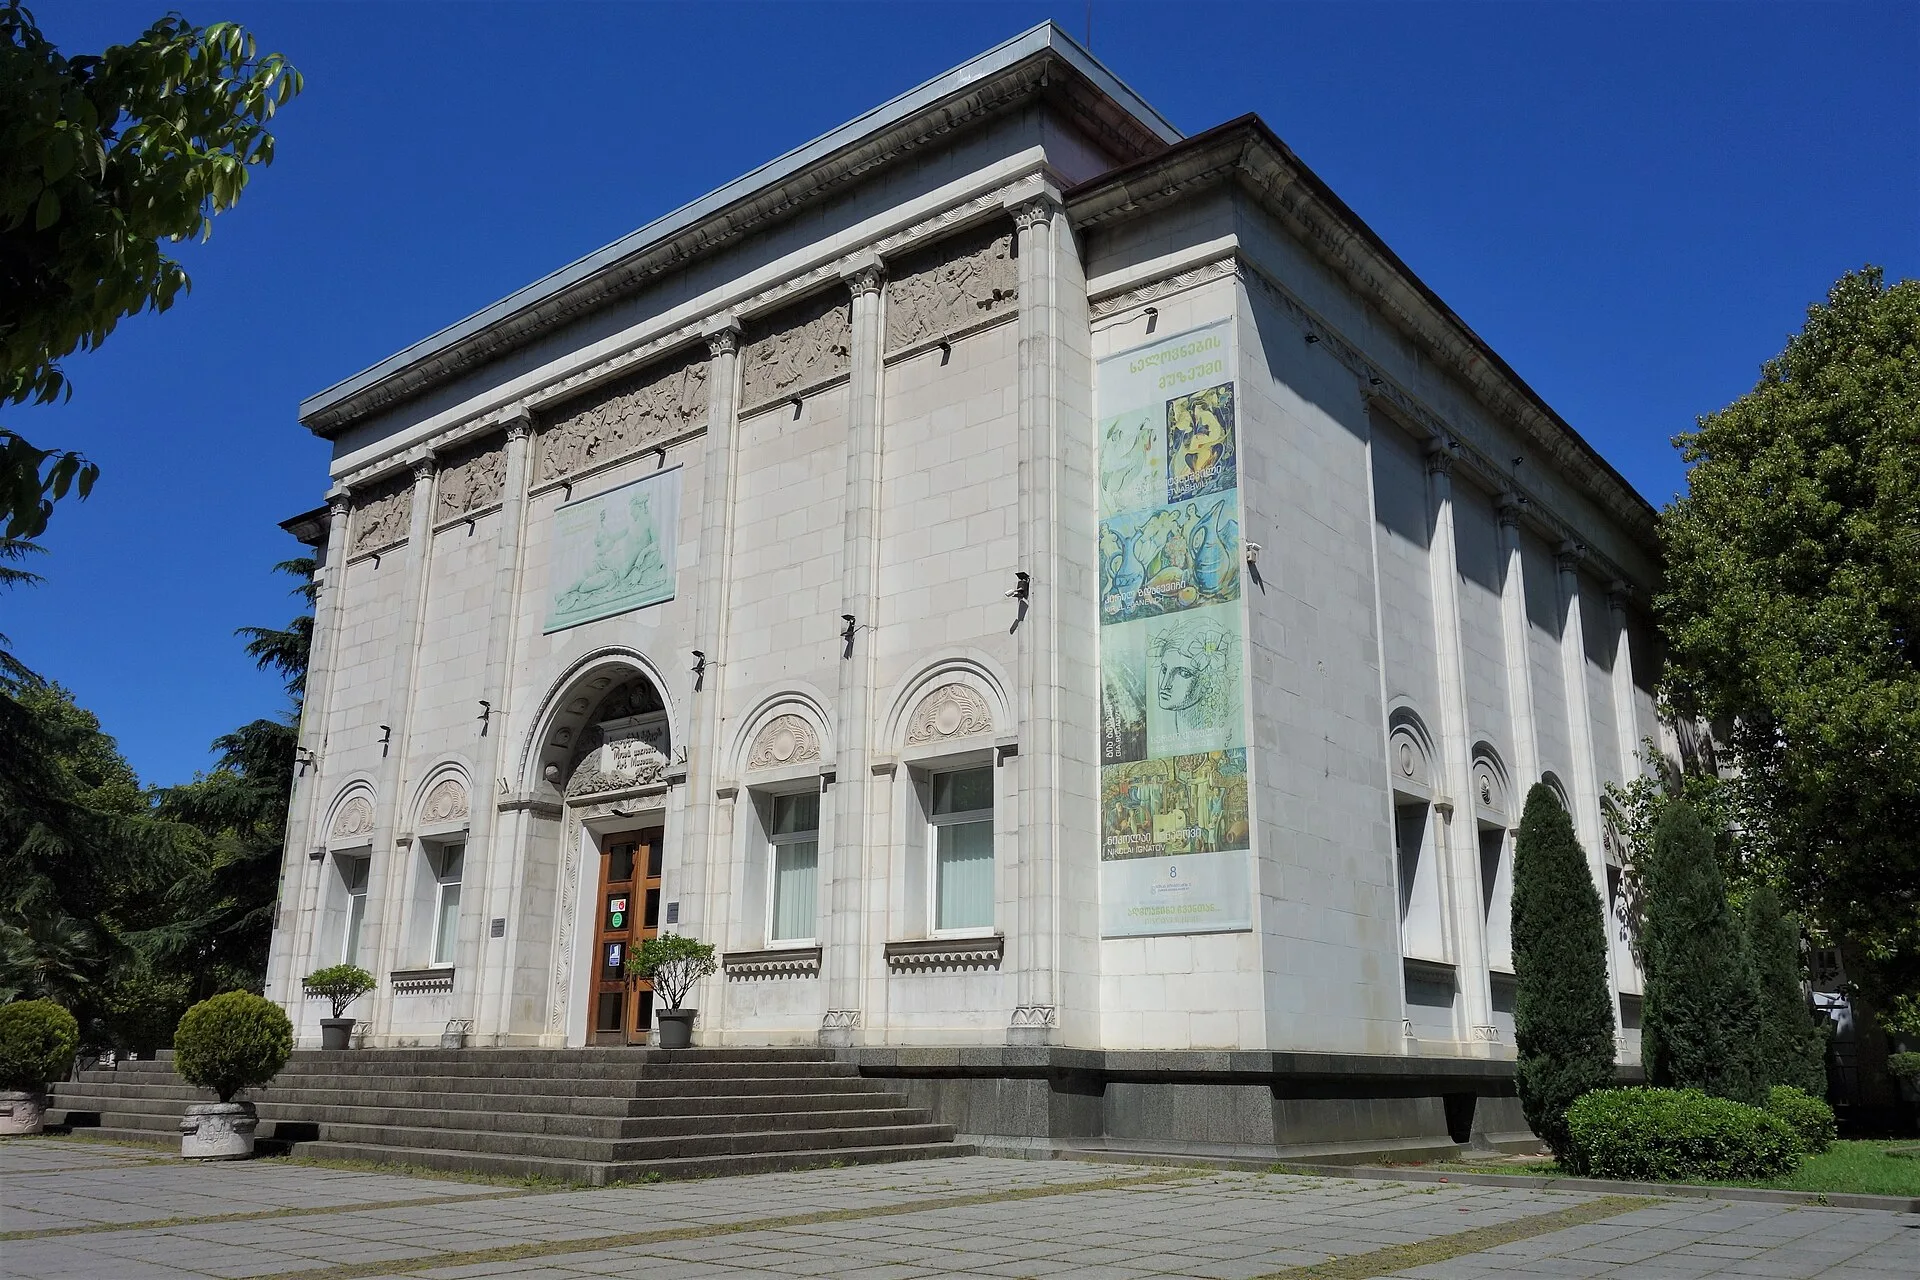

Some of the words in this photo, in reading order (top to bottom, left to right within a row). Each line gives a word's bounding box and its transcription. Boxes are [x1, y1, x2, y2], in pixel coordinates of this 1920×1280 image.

[1129, 335, 1221, 374] ხელოვნების
[1158, 359, 1222, 389] მუზეუმი
[1105, 741, 1113, 758] გია
[1107, 846, 1133, 855] NIKOLAI
[1136, 844, 1166, 853] IGNATOV
[1169, 865, 1177, 878] 8
